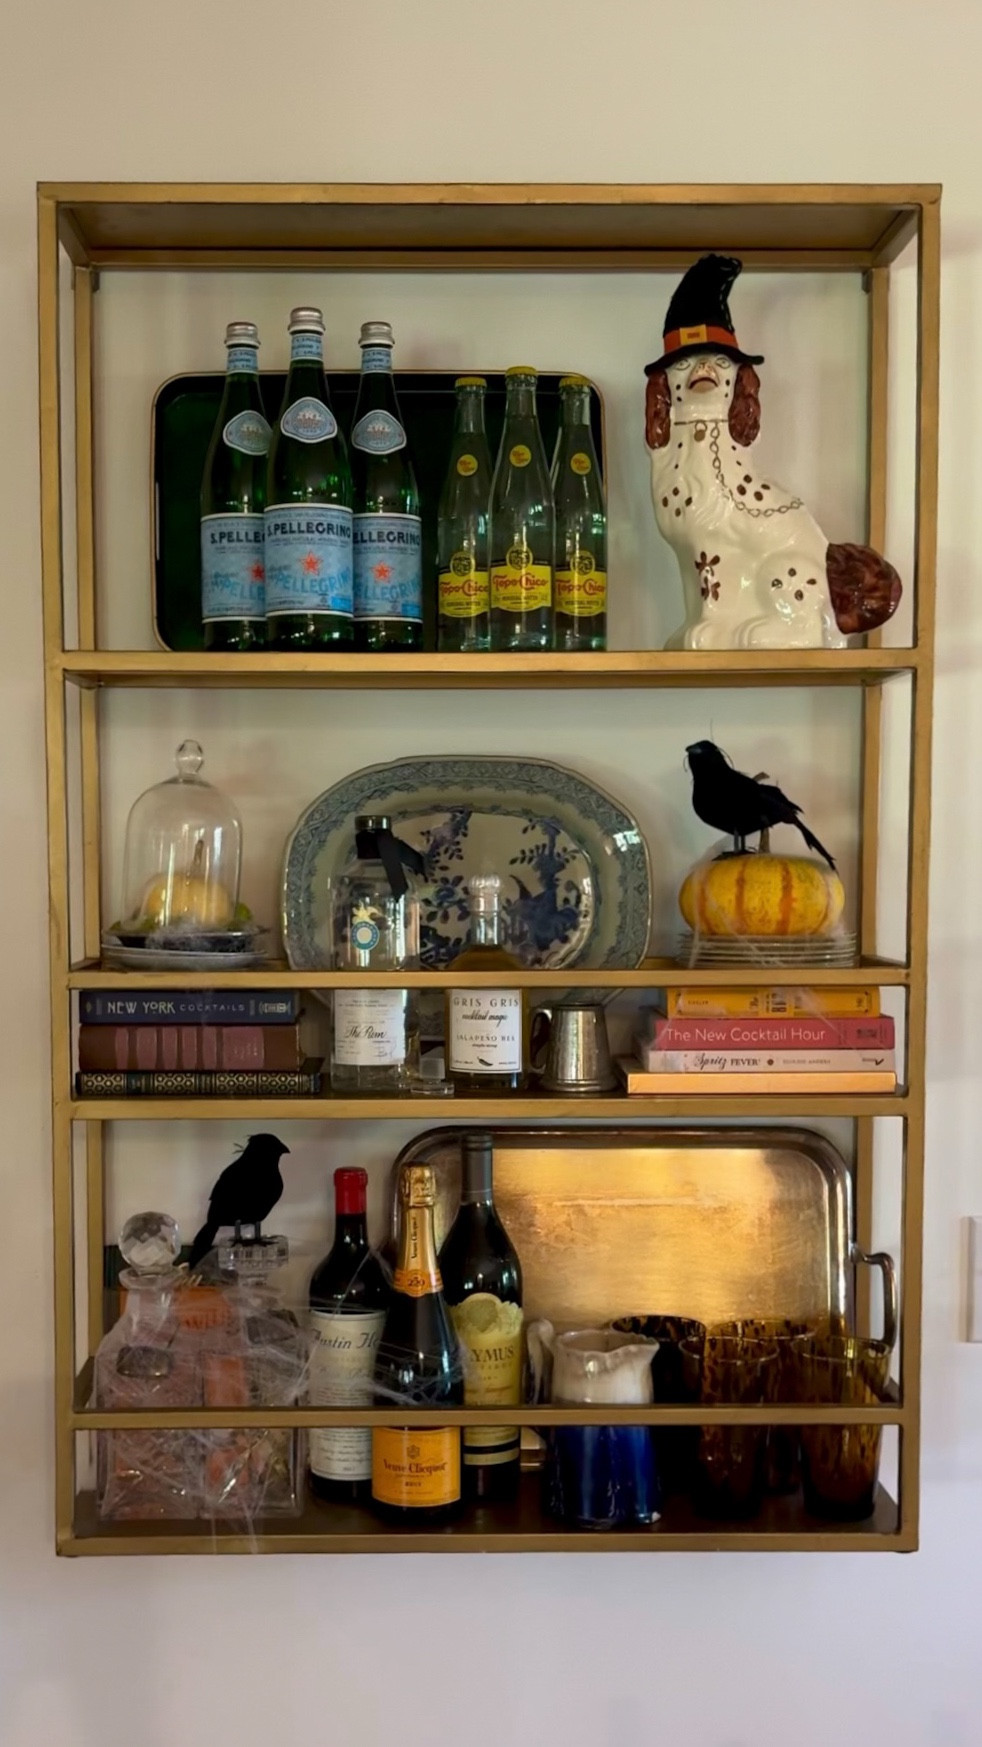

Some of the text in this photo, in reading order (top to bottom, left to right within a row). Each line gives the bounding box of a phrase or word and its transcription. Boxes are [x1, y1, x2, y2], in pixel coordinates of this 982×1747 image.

[210, 531, 265, 544] S.PELLE
[352, 531, 420, 546] ELLEGRINO
[440, 581, 461, 597] Topo
[493, 571, 549, 592] Topo Chico
[556, 579, 581, 596] Topo
[107, 1001, 245, 1014] NEW YORK COCKTAILS
[453, 997, 519, 1008] GRIS GRIS
[667, 1027, 827, 1041] The New Cocktail Hour
[470, 1345, 514, 1362] YMUS
